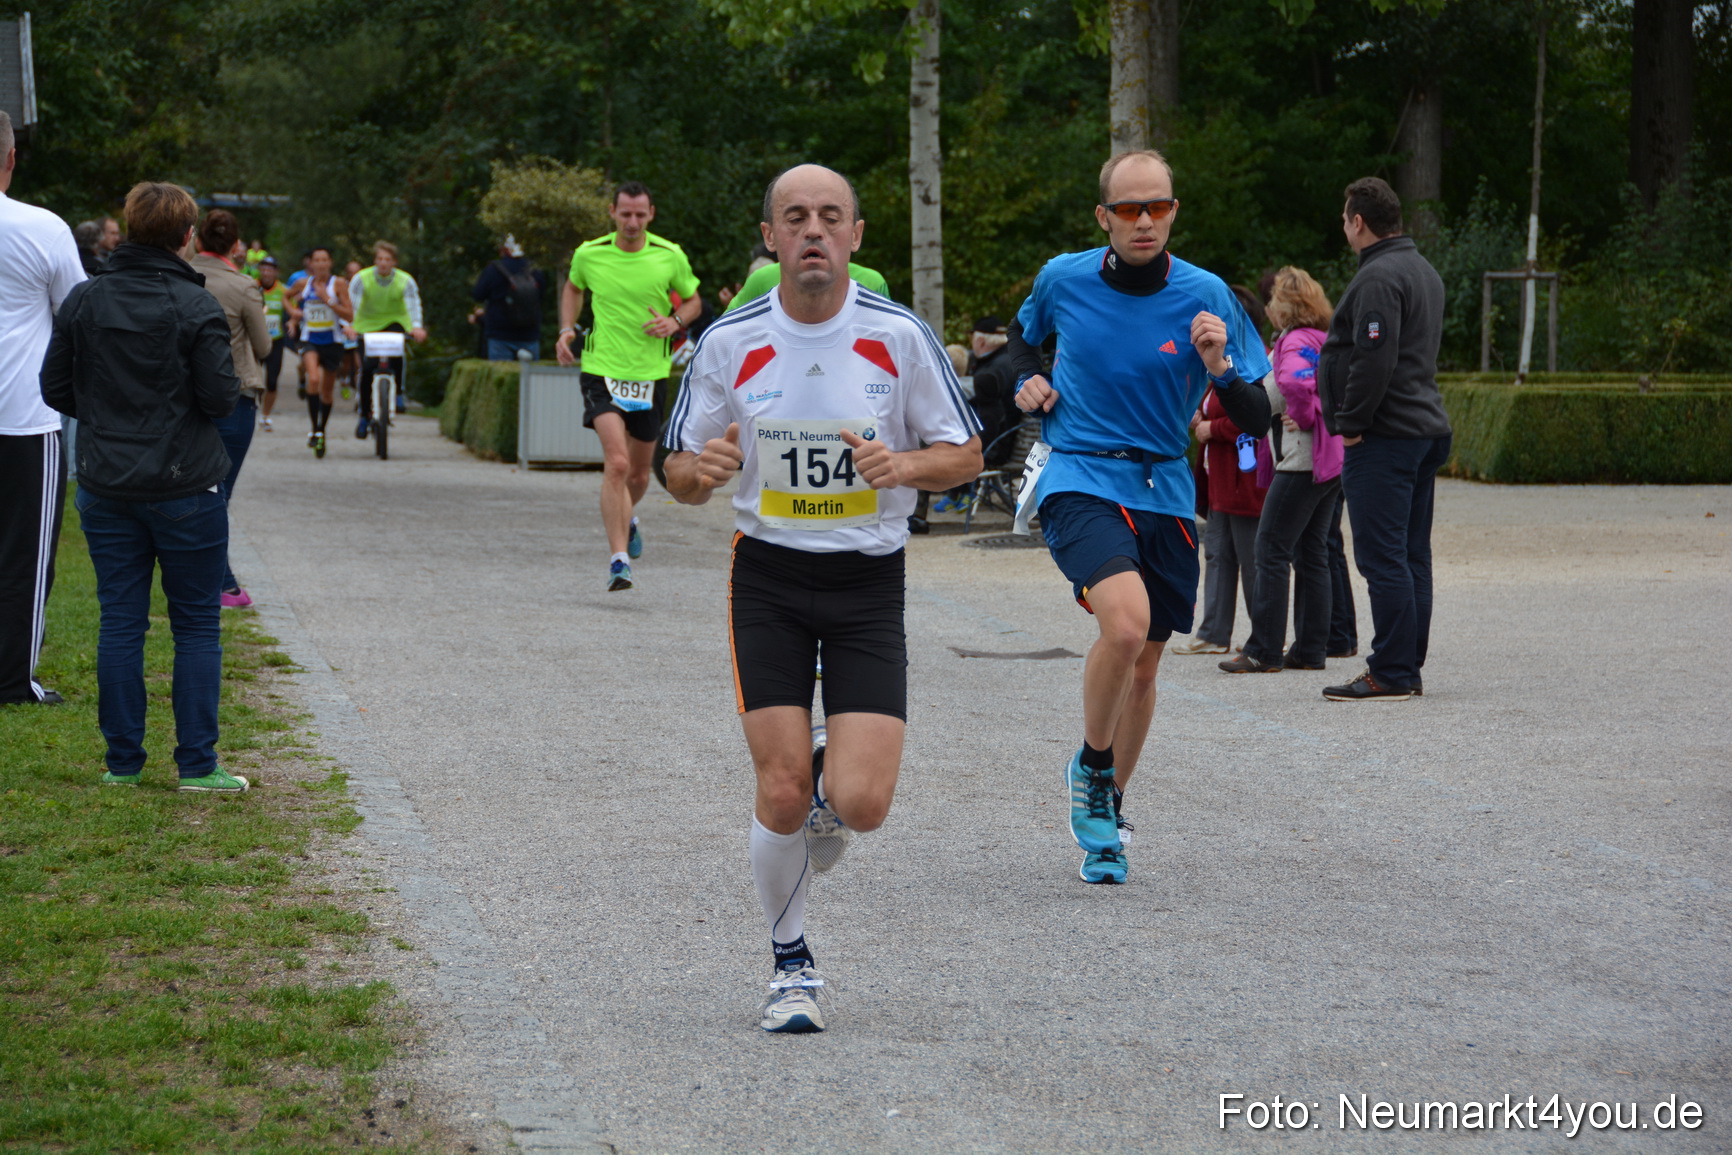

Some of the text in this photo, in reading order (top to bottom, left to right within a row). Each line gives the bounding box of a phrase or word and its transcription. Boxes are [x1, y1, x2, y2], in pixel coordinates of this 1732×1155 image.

[758, 429, 857, 441] PARTL Neuma
[781, 447, 856, 488] 154
[792, 499, 844, 515] Martin
